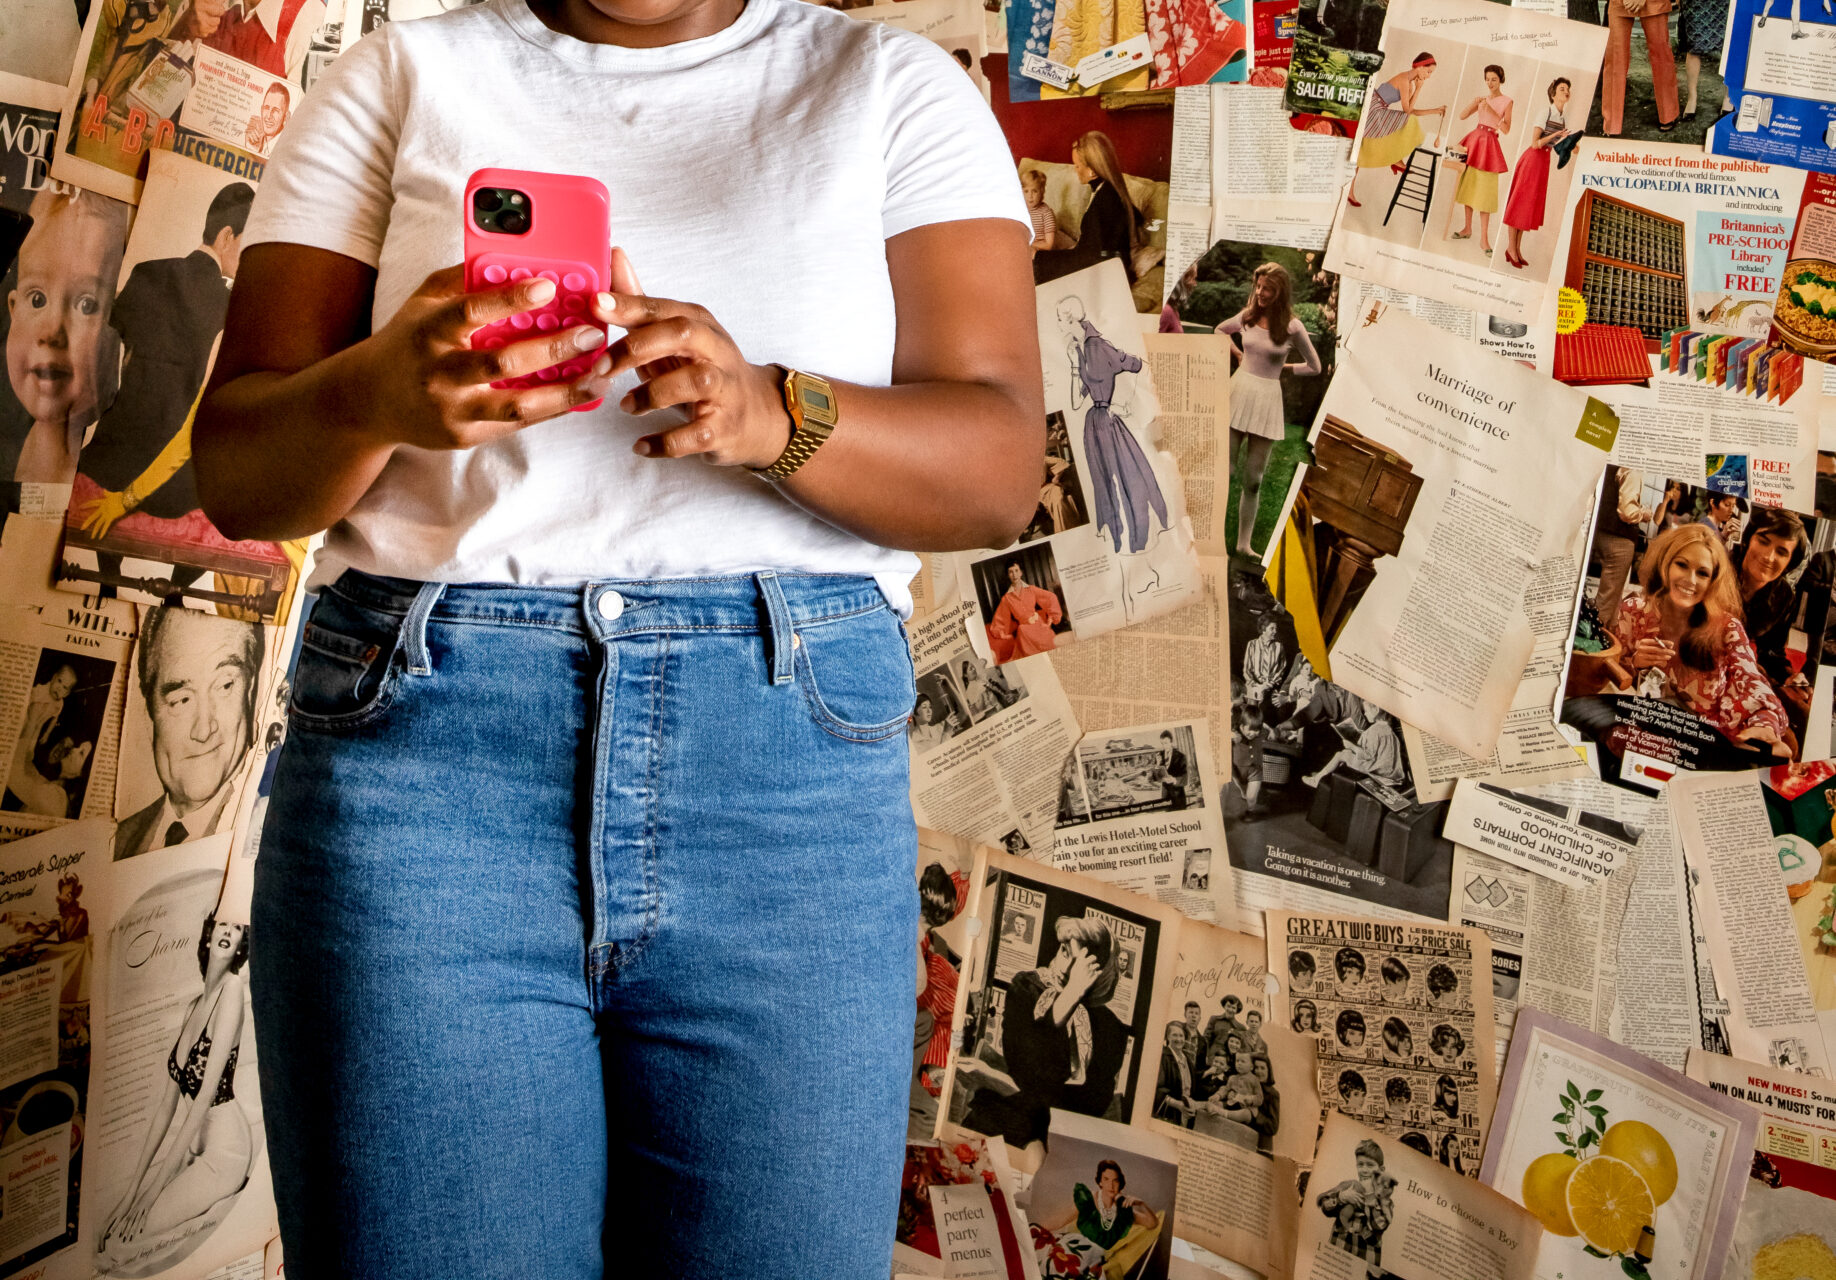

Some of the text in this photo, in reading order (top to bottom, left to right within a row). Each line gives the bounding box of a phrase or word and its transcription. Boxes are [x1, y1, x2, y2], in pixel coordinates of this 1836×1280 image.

[1031, 66, 1062, 81] CANNON
[1295, 81, 1335, 100] SALEM
[1593, 151, 1771, 174] Available direct from the publisher
[21, 156, 82, 205] Day
[1582, 174, 1780, 200] ENCYCLOPAEDIA BRITANNICA
[1721, 218, 1785, 235] Britannica's
[1730, 249, 1773, 266] Library
[1724, 273, 1776, 294] FREE
[1480, 338, 1535, 349] Shows How To
[1502, 350, 1537, 359] Dentures
[1425, 363, 1517, 415] Marriage of
[1416, 392, 1511, 441] convenience
[1753, 459, 1790, 474] FREE!
[1065, 821, 1202, 847] the Lewis Hotel-Motel School
[1473, 817, 1536, 849] PORTRAITS
[1520, 820, 1614, 863] OF CHILDHOOD
[1266, 844, 1296, 864] Taking
[1302, 857, 1336, 872] vacation
[1338, 862, 1345, 873] is
[1345, 868, 1361, 878] one
[1264, 858, 1351, 888] Going on it is another.
[1287, 918, 1404, 945] GREAT WIG BUYS
[1409, 927, 1464, 938] LESS THAN
[124, 930, 191, 969] Charm
[1421, 935, 1448, 949] PRICE
[1450, 938, 1471, 952] SALE
[1747, 1076, 1822, 1100] NEW MIXES! So
[1709, 1081, 1835, 1121] WIN ON ALL 4 "MUSTS" FOR
[941, 1192, 948, 1204] 4
[944, 1206, 984, 1226] perfect
[1406, 1179, 1518, 1251] How to choose a Boy
[947, 1228, 979, 1245] party
[951, 1248, 992, 1262] menus
